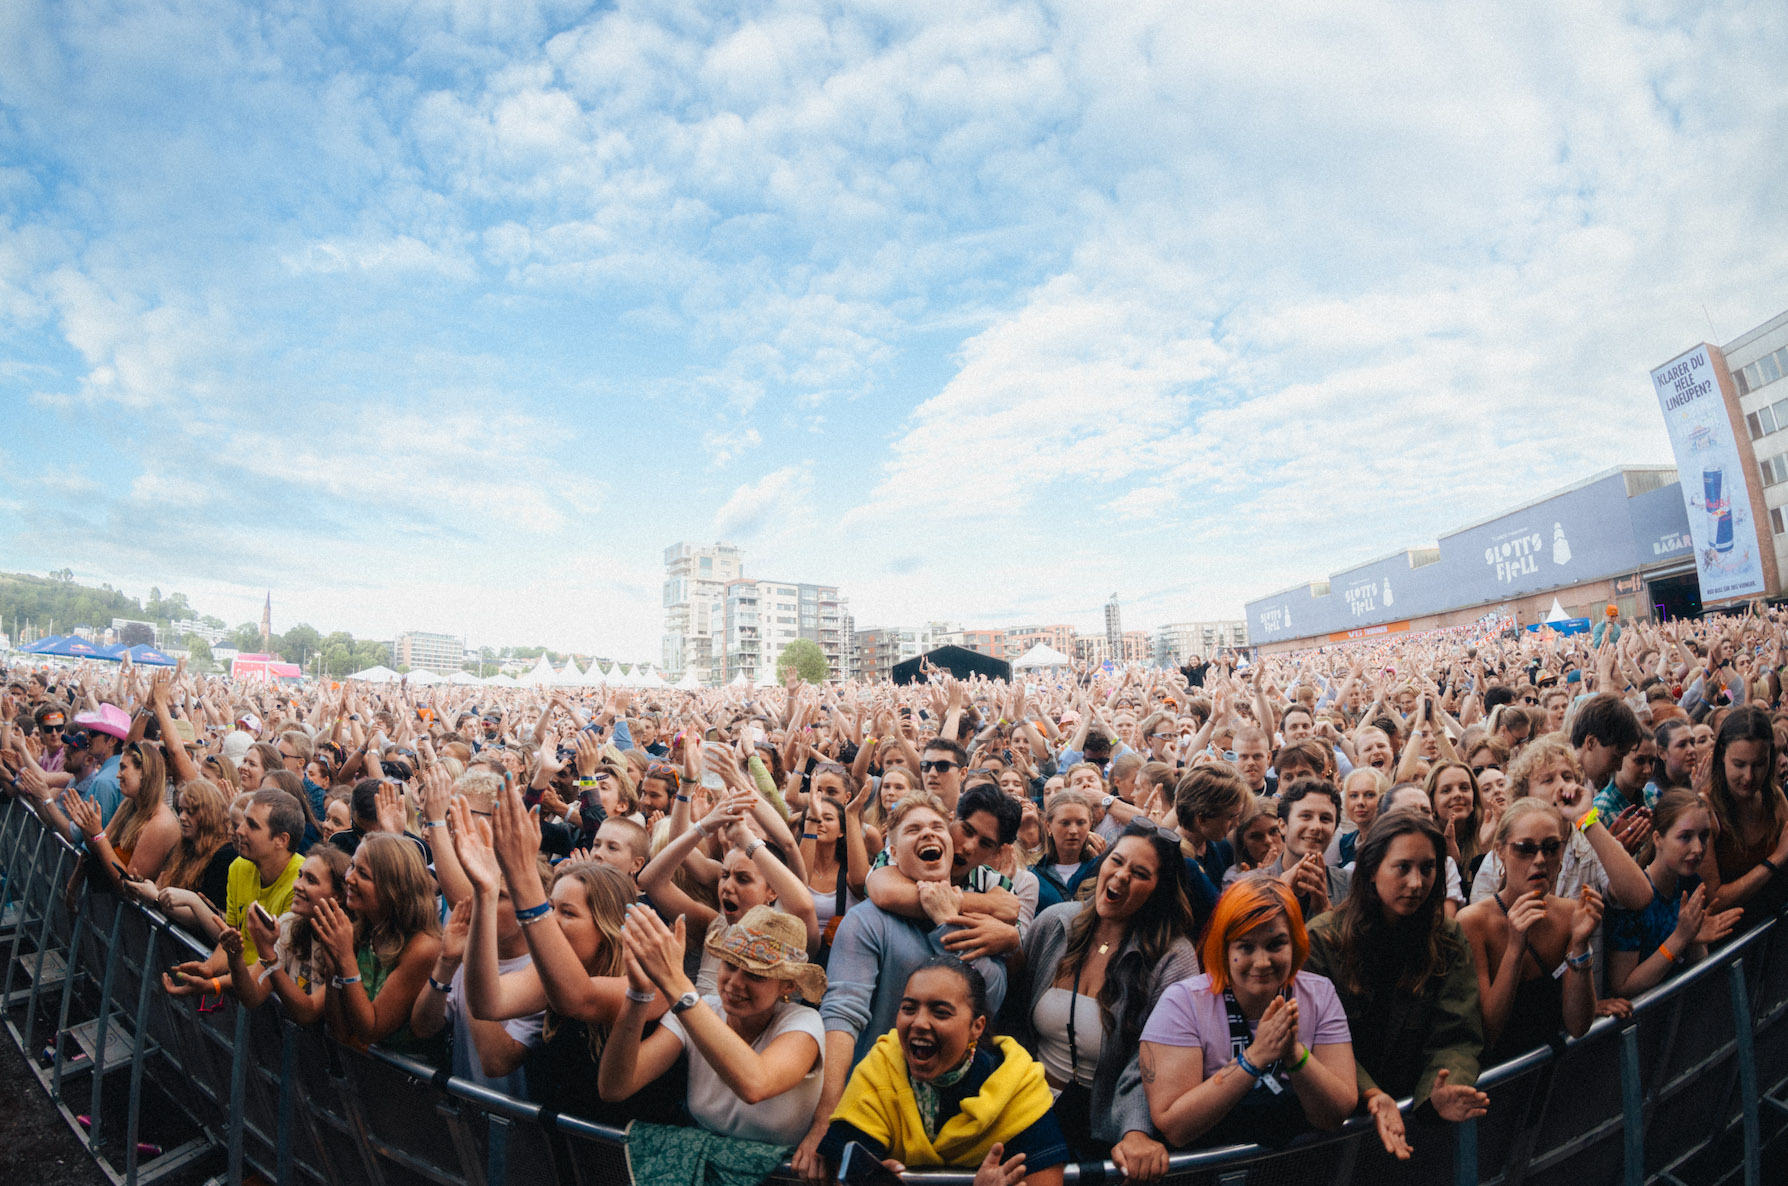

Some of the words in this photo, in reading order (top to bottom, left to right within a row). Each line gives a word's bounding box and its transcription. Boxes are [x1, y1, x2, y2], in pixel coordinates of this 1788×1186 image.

[1657, 361, 1689, 387] KLARER
[1690, 353, 1705, 371] DU
[1674, 373, 1695, 393] HELE
[1665, 380, 1712, 412] LINEUPEN?
[1485, 533, 1542, 565] SLOTTS
[1345, 582, 1377, 604] SLOTTS
[1348, 629, 1363, 638] VG
